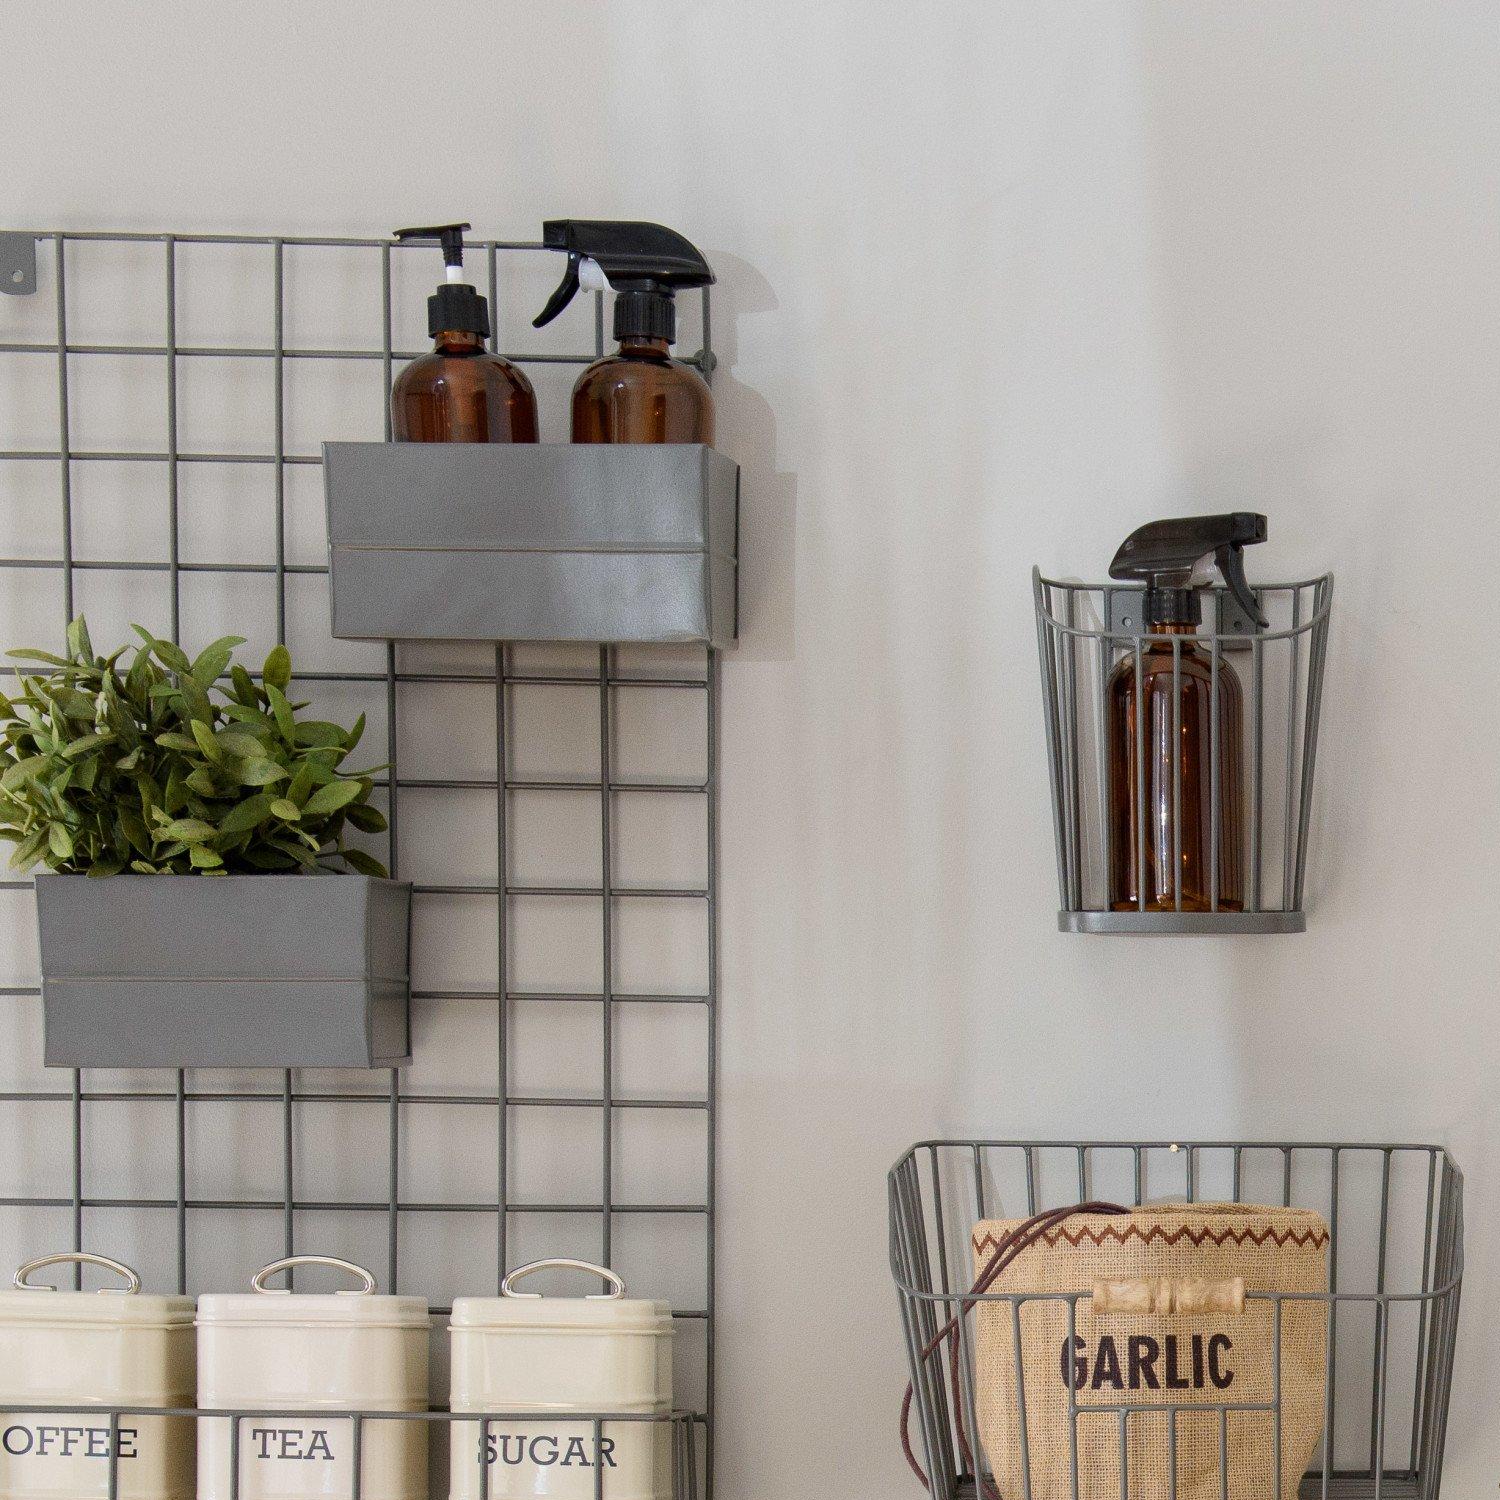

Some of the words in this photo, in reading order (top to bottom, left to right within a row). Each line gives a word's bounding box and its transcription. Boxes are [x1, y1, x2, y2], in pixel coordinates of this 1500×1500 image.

[1060, 1333, 1235, 1390] GARLIC
[252, 1428, 335, 1460] TEA
[477, 1434, 618, 1467] SUGAR
